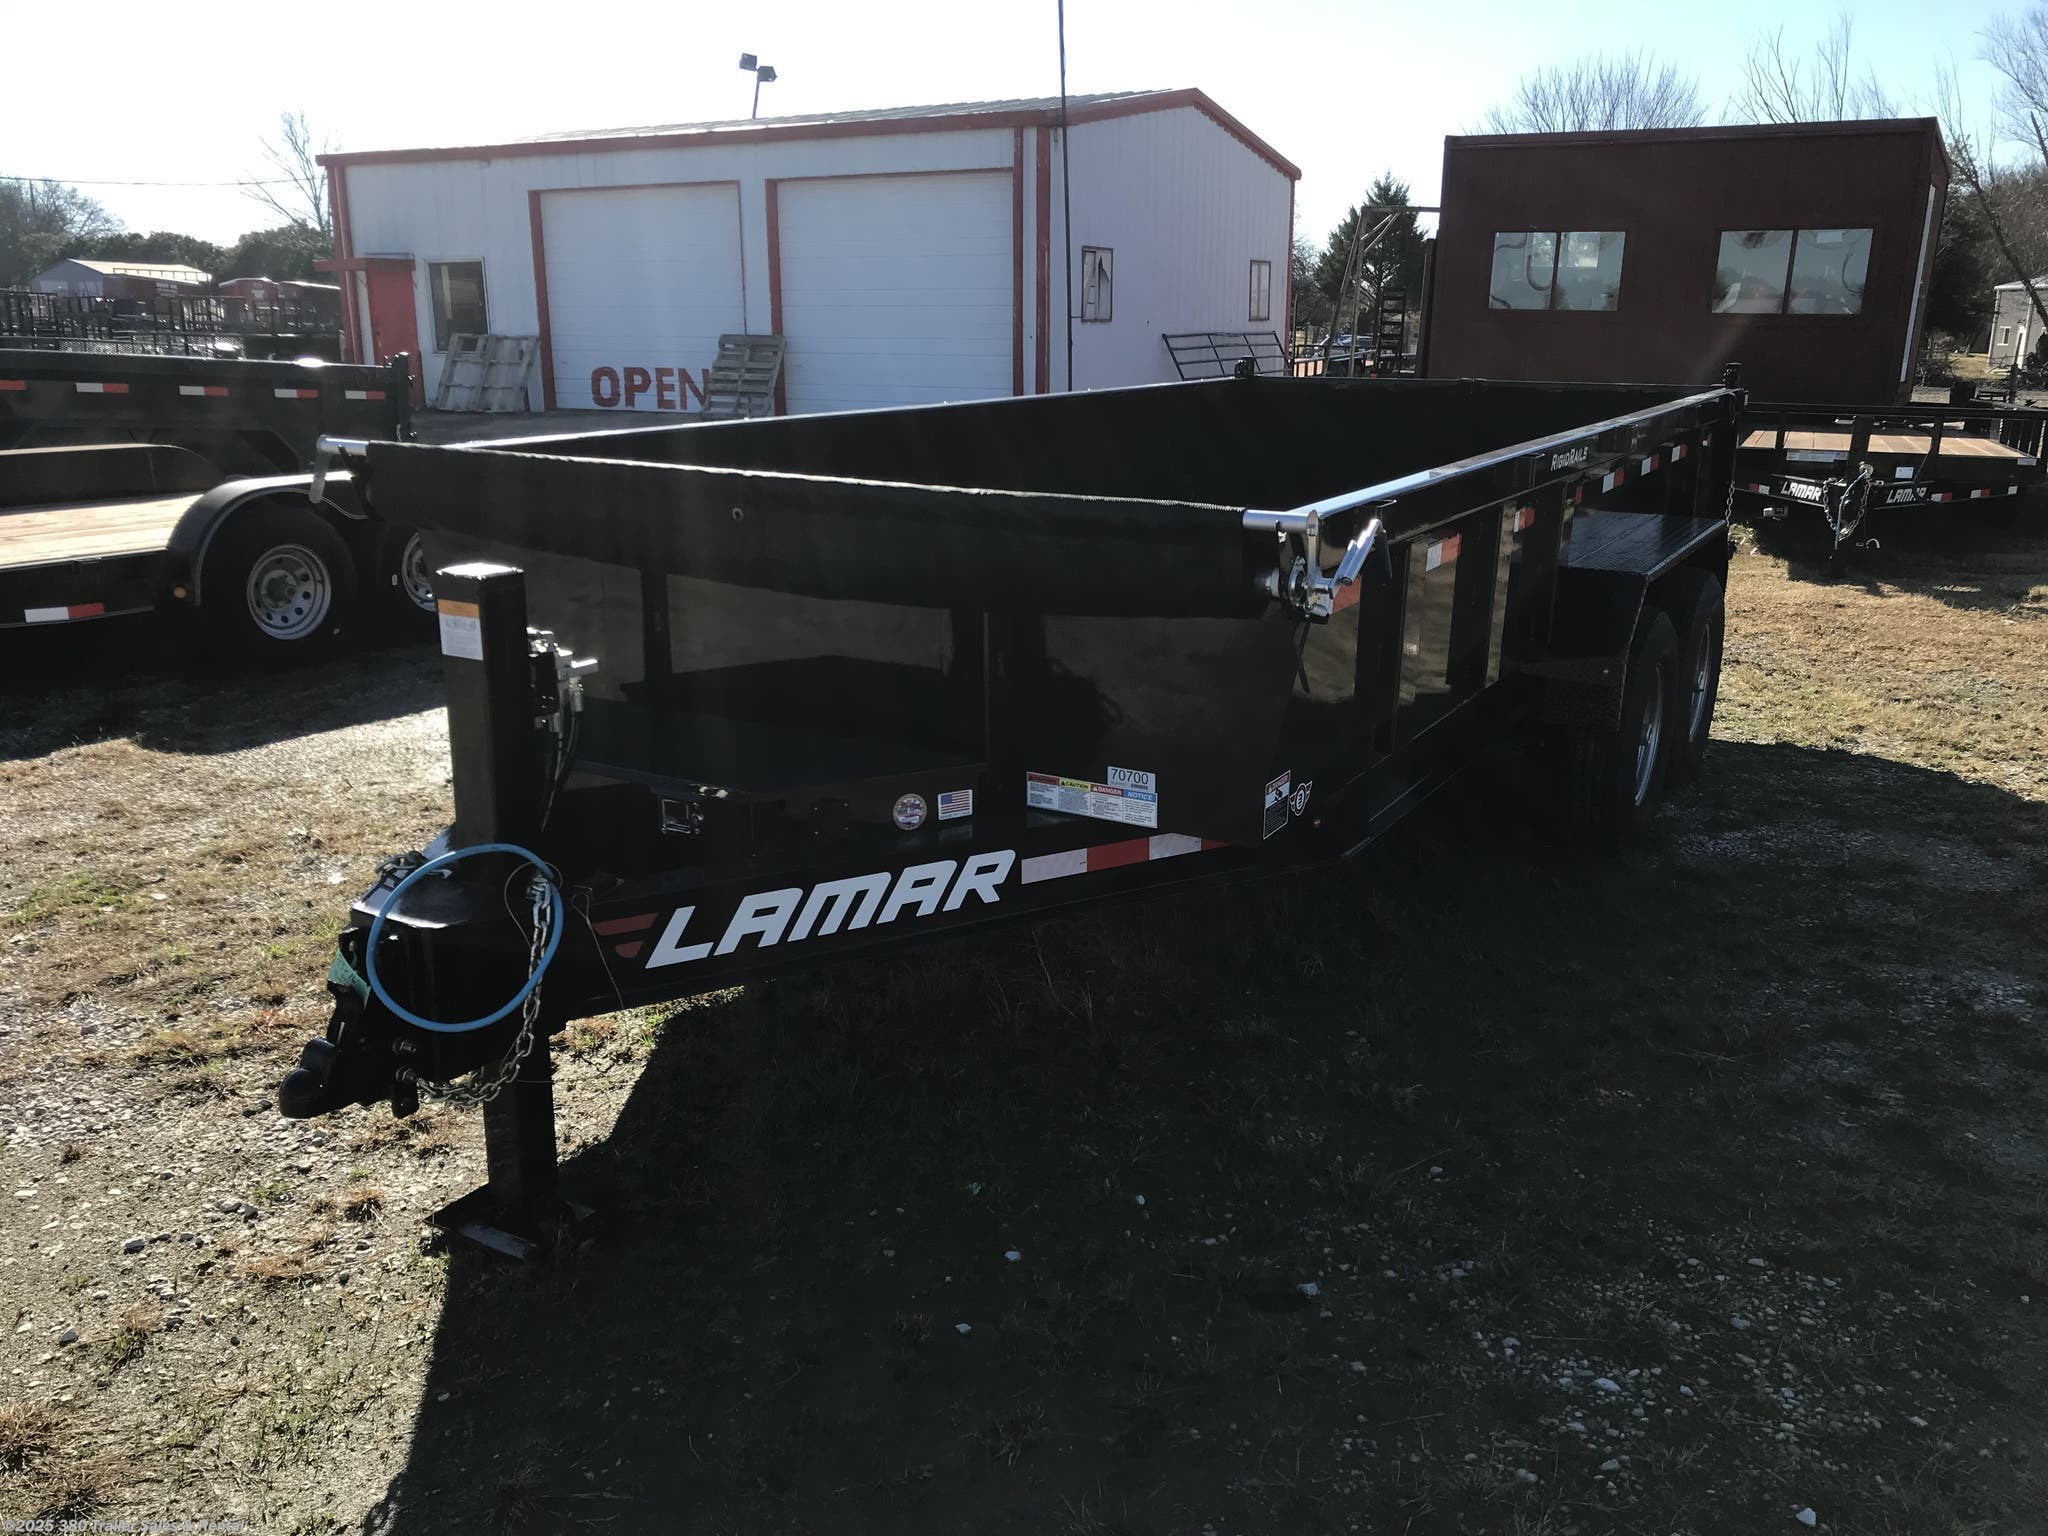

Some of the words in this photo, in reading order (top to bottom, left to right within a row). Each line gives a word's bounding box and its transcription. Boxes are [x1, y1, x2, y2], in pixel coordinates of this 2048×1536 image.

[590, 366, 712, 411] OPEN
[1780, 481, 1823, 502] LAMAR
[1111, 767, 1149, 785] 70700
[1064, 781, 1090, 790] CAUTION
[1097, 786, 1123, 796] DANGER
[1127, 790, 1153, 801] NOTICE
[644, 849, 1016, 969] LAMAR
